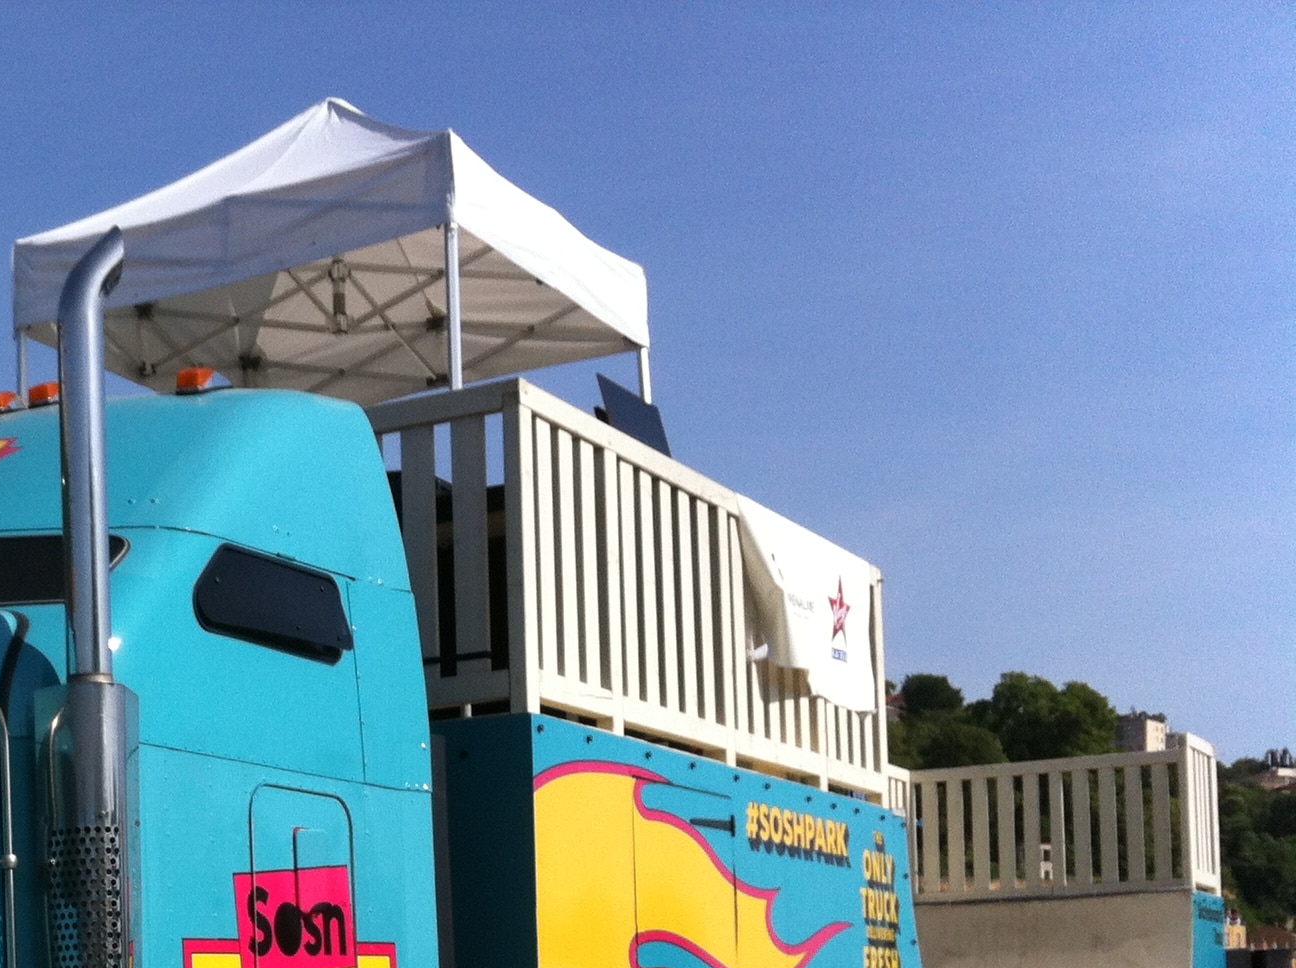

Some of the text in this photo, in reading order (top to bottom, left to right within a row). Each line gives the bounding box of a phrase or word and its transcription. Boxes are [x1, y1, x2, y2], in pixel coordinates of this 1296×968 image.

[745, 801, 849, 858] #SOSHPARK
[863, 849, 894, 885] ONLY
[860, 887, 899, 925] TRUCK
